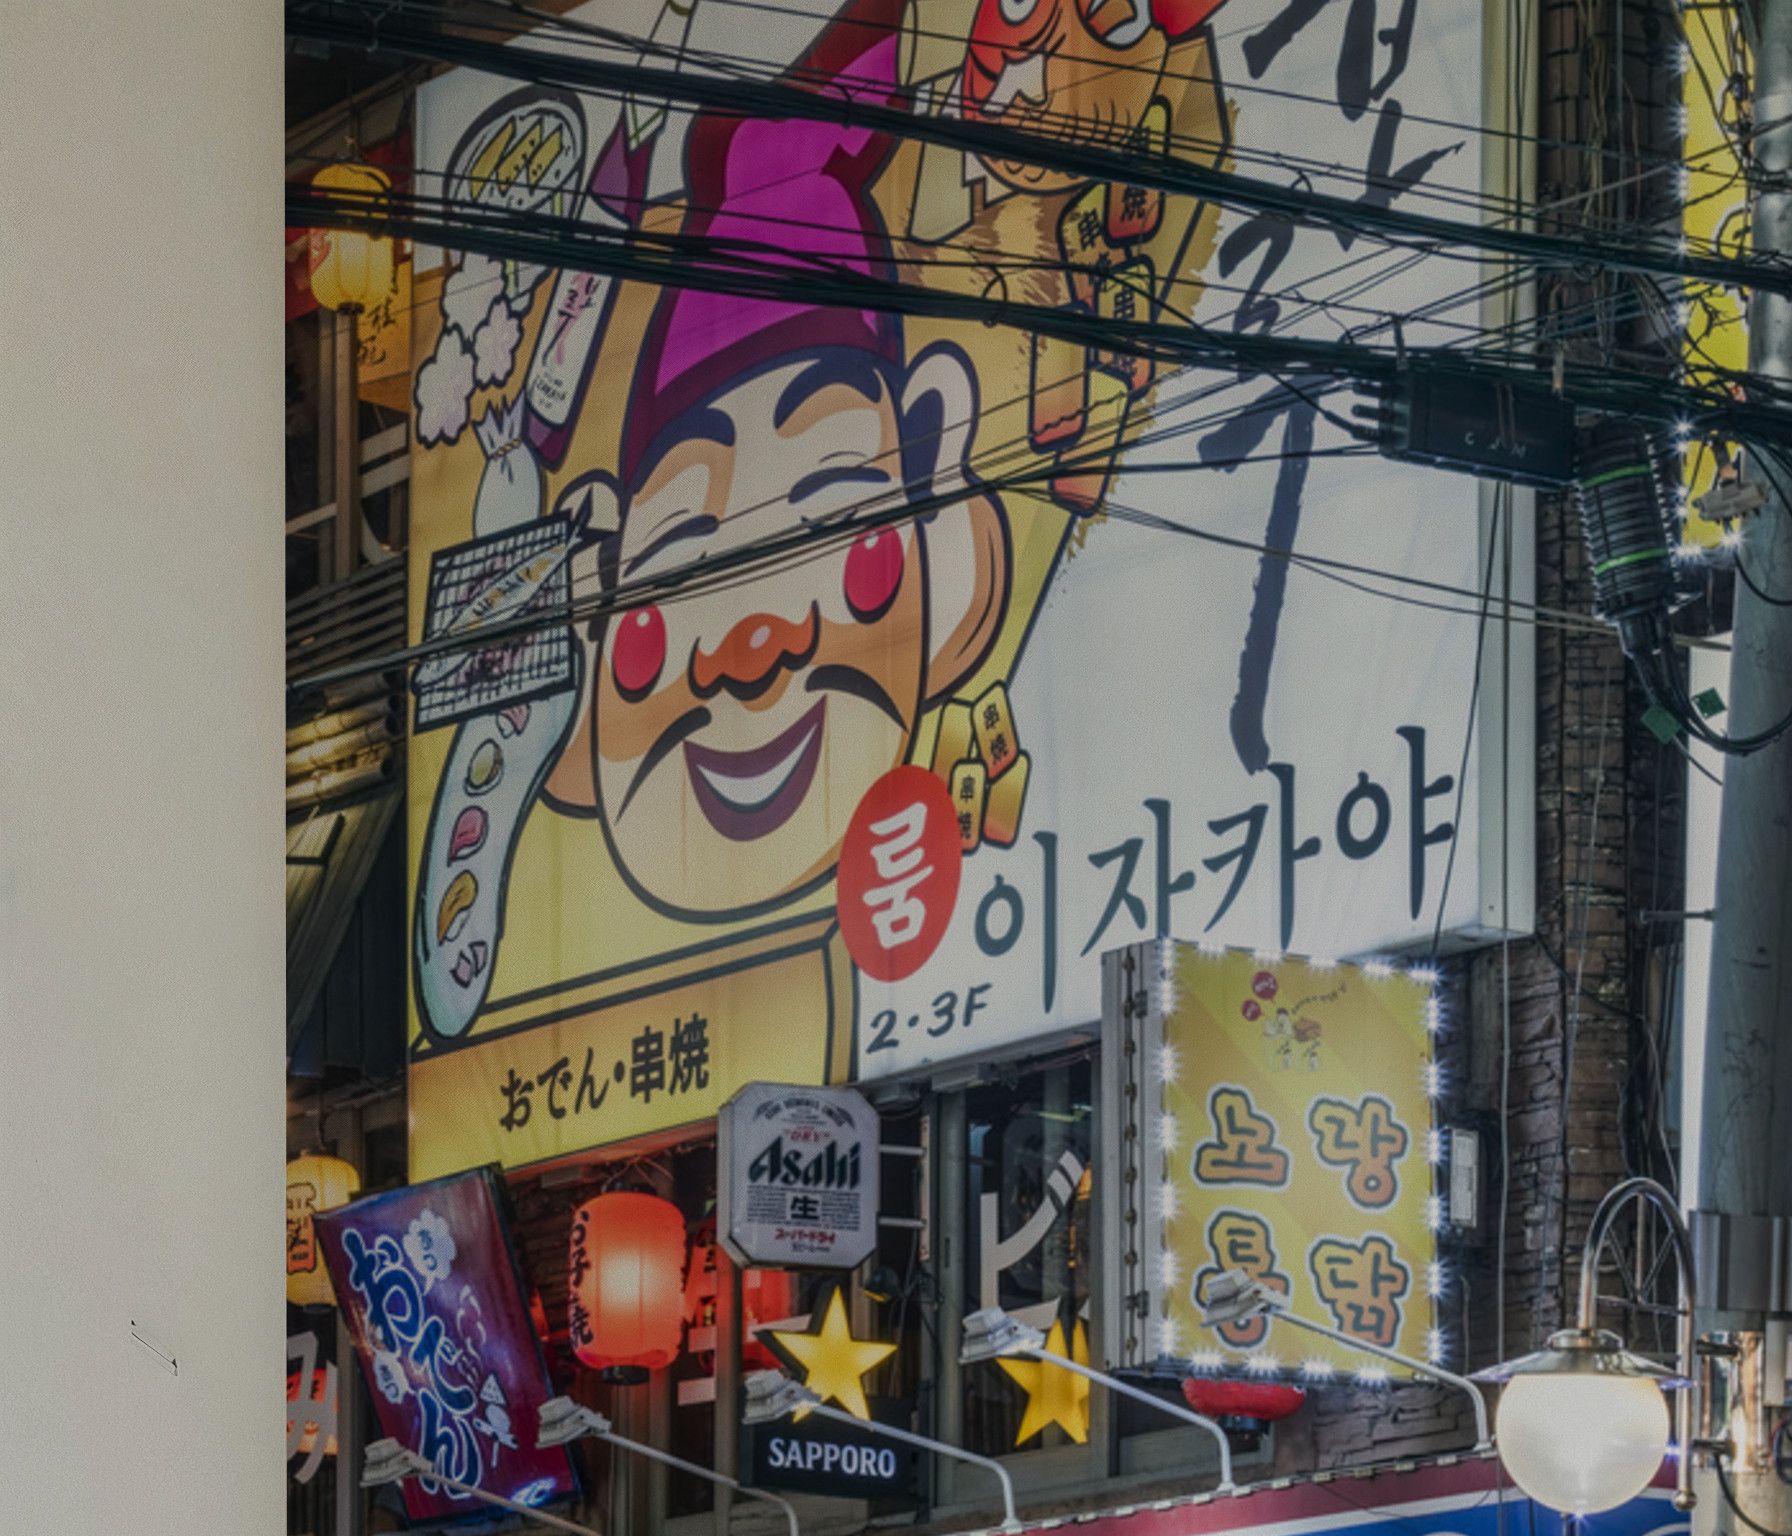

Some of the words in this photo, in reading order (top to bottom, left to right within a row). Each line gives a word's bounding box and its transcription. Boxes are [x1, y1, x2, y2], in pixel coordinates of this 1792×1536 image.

[862, 802, 934, 948] 룸
[973, 725, 1455, 1013] 이자카야
[748, 1136, 861, 1190] Asahi
[1194, 1087, 1410, 1208] 노랑
[790, 1194, 820, 1220] 生
[769, 1437, 897, 1479] SAPPORO
